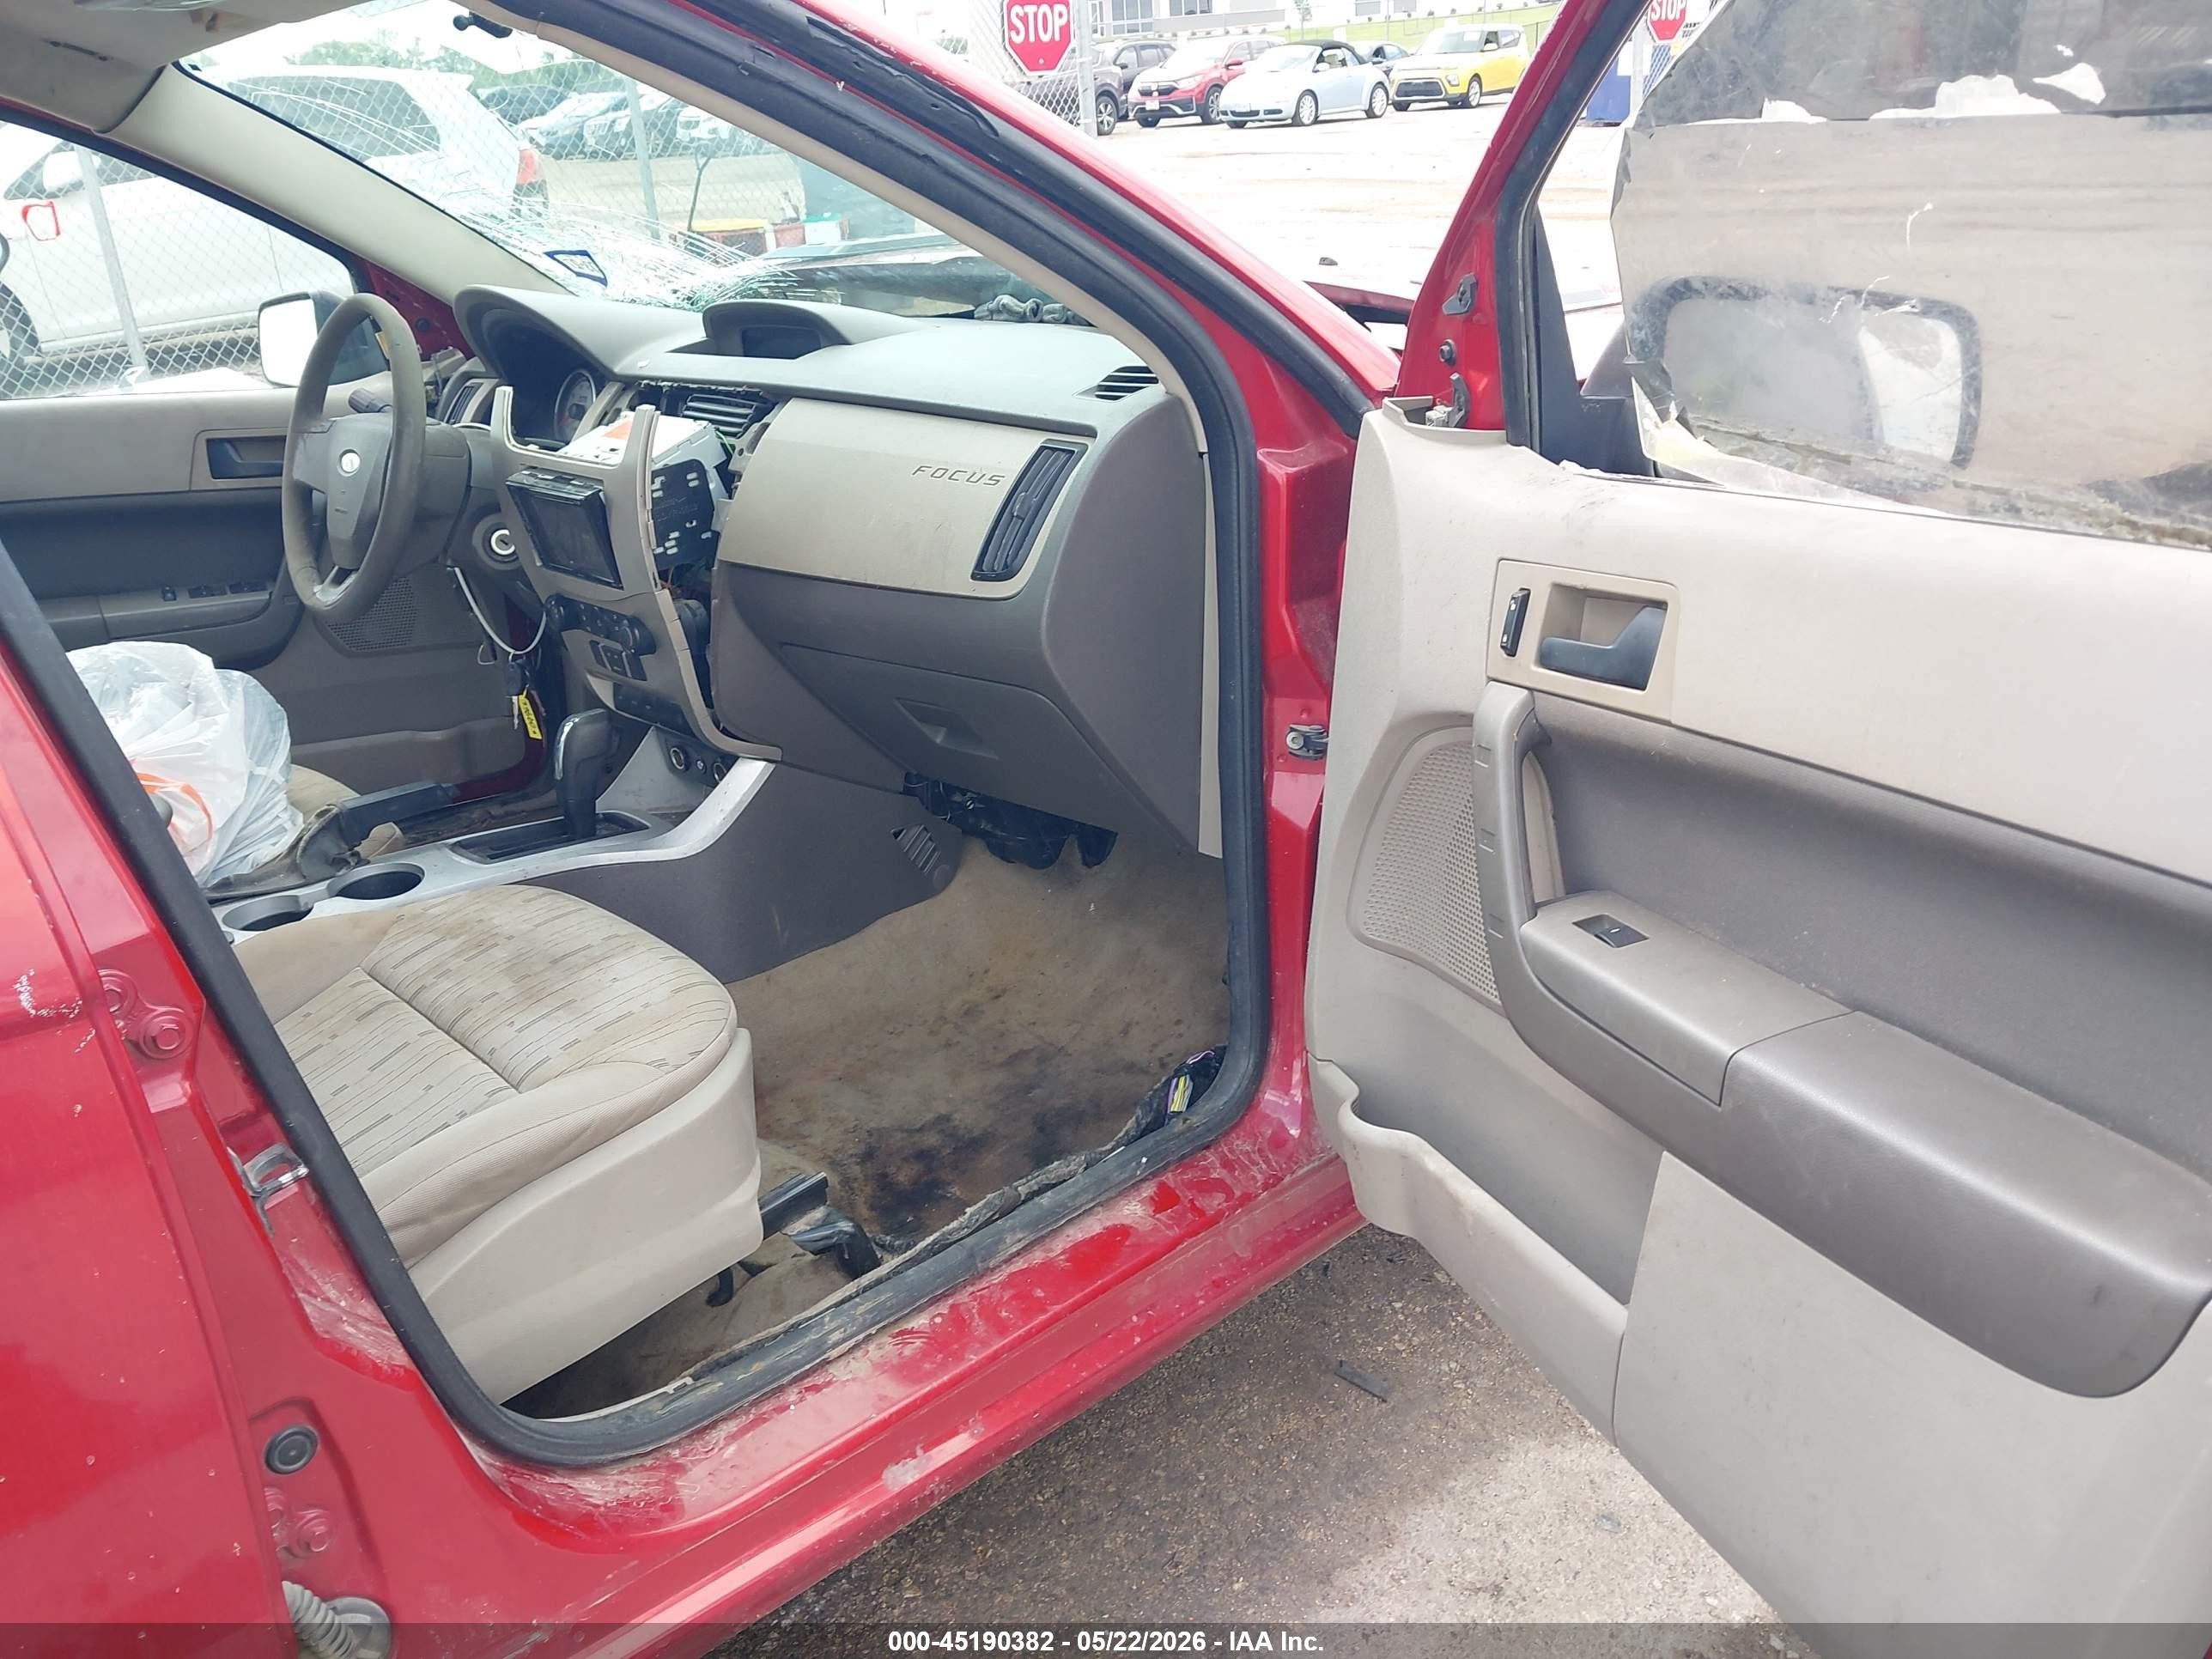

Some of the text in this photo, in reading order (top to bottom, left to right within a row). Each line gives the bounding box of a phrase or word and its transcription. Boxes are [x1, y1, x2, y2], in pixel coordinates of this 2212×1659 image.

[1650, 0, 1686, 21] STOP
[1010, 3, 1068, 44] STOP
[912, 465, 1006, 486] FOCUS
